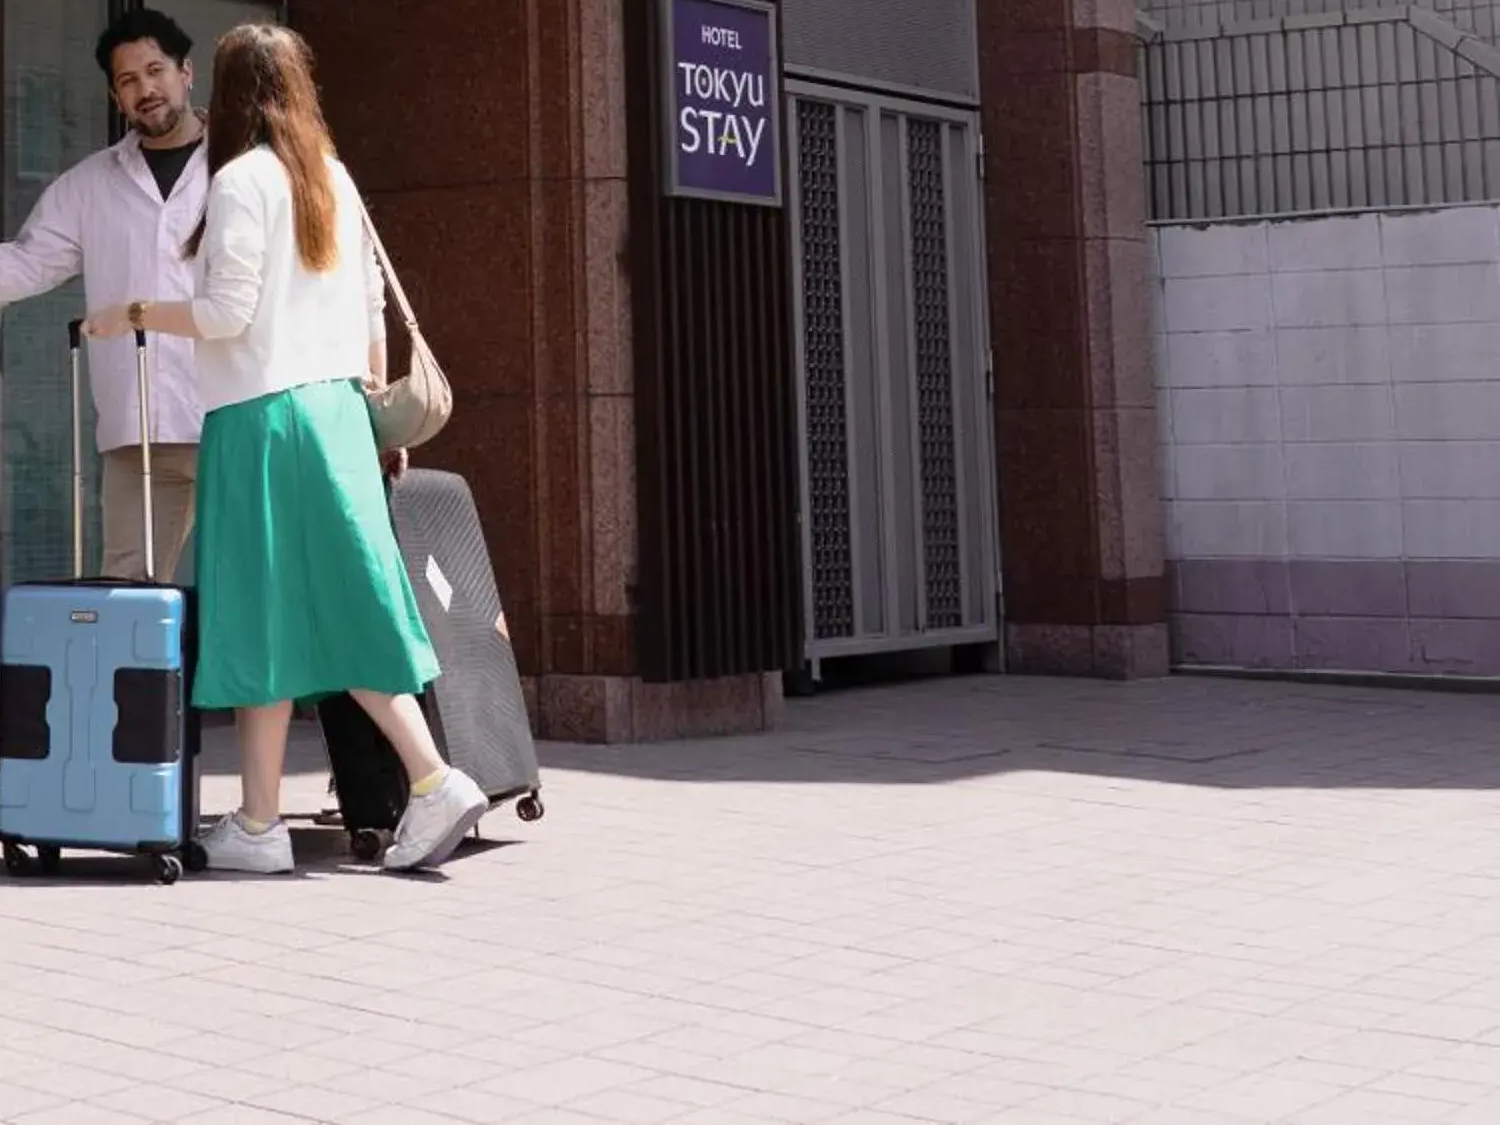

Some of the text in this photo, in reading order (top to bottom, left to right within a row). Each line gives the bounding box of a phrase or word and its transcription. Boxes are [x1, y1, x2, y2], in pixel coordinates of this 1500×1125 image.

[701, 25, 743, 50] HOTEL
[677, 62, 764, 108] TOKYU
[680, 106, 766, 166] STAY
